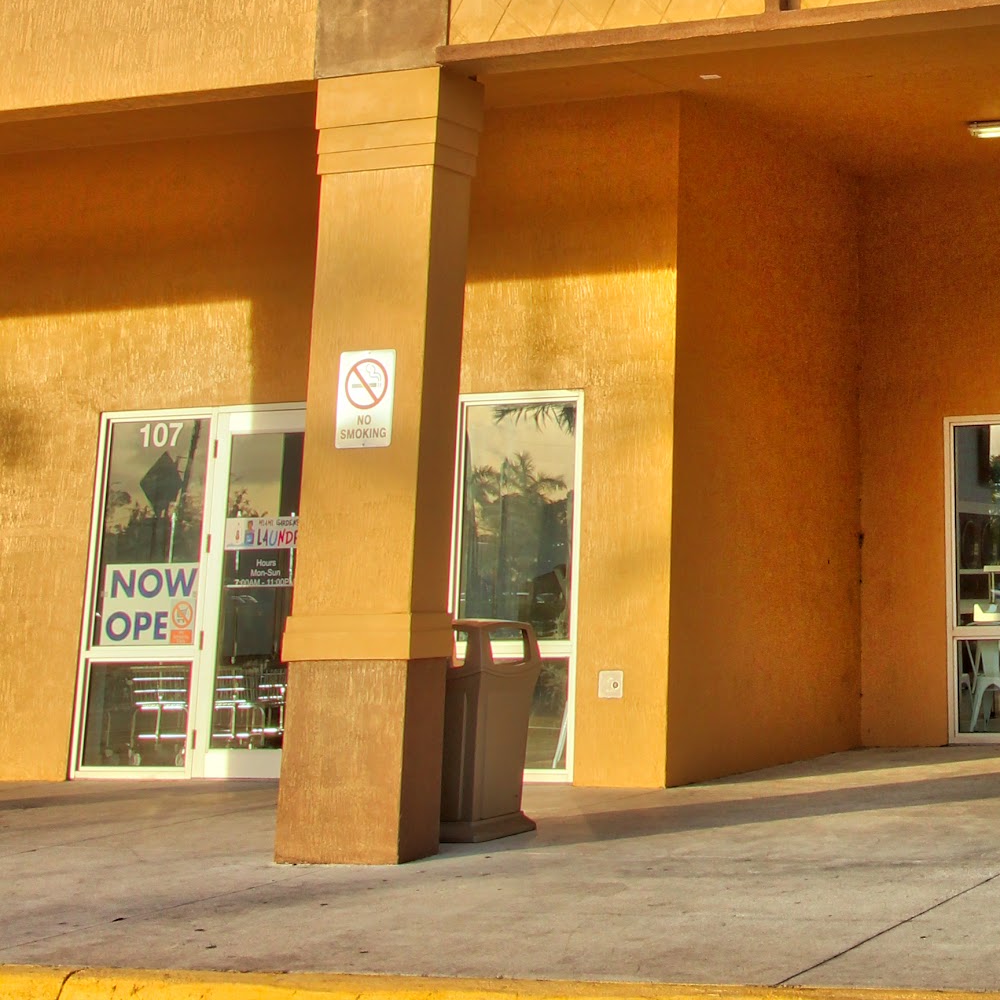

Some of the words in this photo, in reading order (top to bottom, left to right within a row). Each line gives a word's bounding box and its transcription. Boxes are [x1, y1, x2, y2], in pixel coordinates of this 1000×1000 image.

[356, 414, 372, 426] NO
[140, 422, 184, 448] 107
[340, 427, 387, 440] SMOKING
[250, 569, 281, 577] Mon-Sun
[110, 568, 199, 598] NOW
[105, 611, 169, 641] OPE
